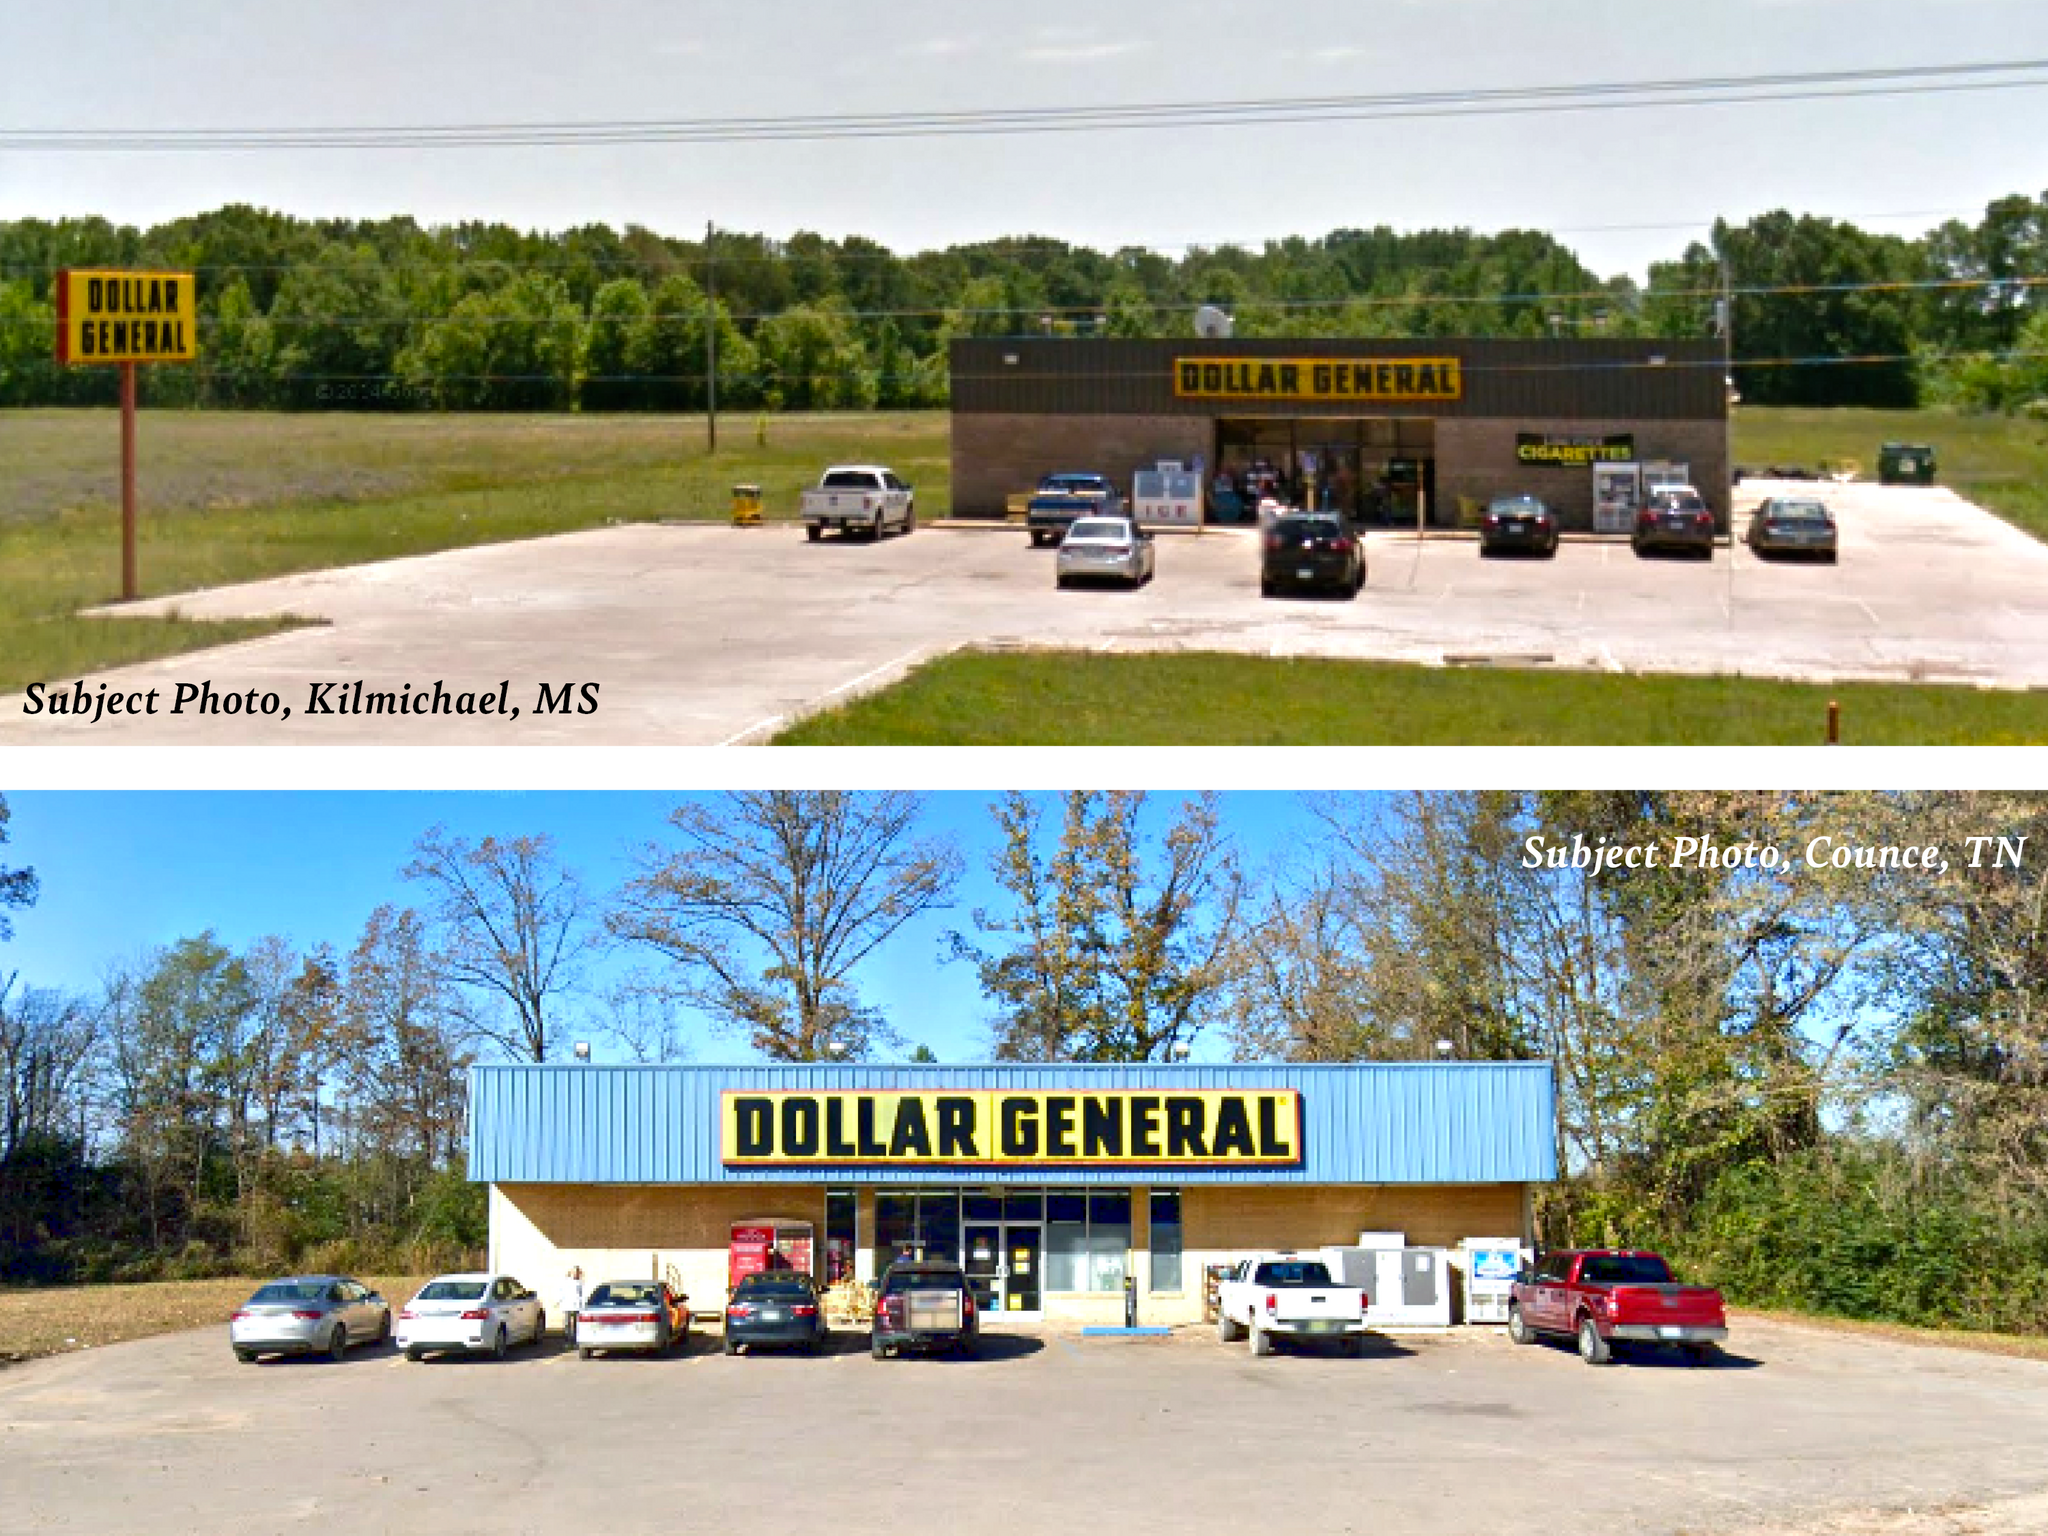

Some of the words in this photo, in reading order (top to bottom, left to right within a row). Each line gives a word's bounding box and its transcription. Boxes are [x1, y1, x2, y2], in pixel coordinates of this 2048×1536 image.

[88, 278, 178, 313] DOLLAR
[82, 320, 187, 355] GENERAL
[1182, 363, 1300, 392] DOLLAR
[1312, 363, 1457, 394] GENERAL
[1517, 444, 1632, 461] CIGARETTES
[733, 1096, 980, 1158] DOLLAR
[1000, 1096, 1290, 1158] GENERAL
